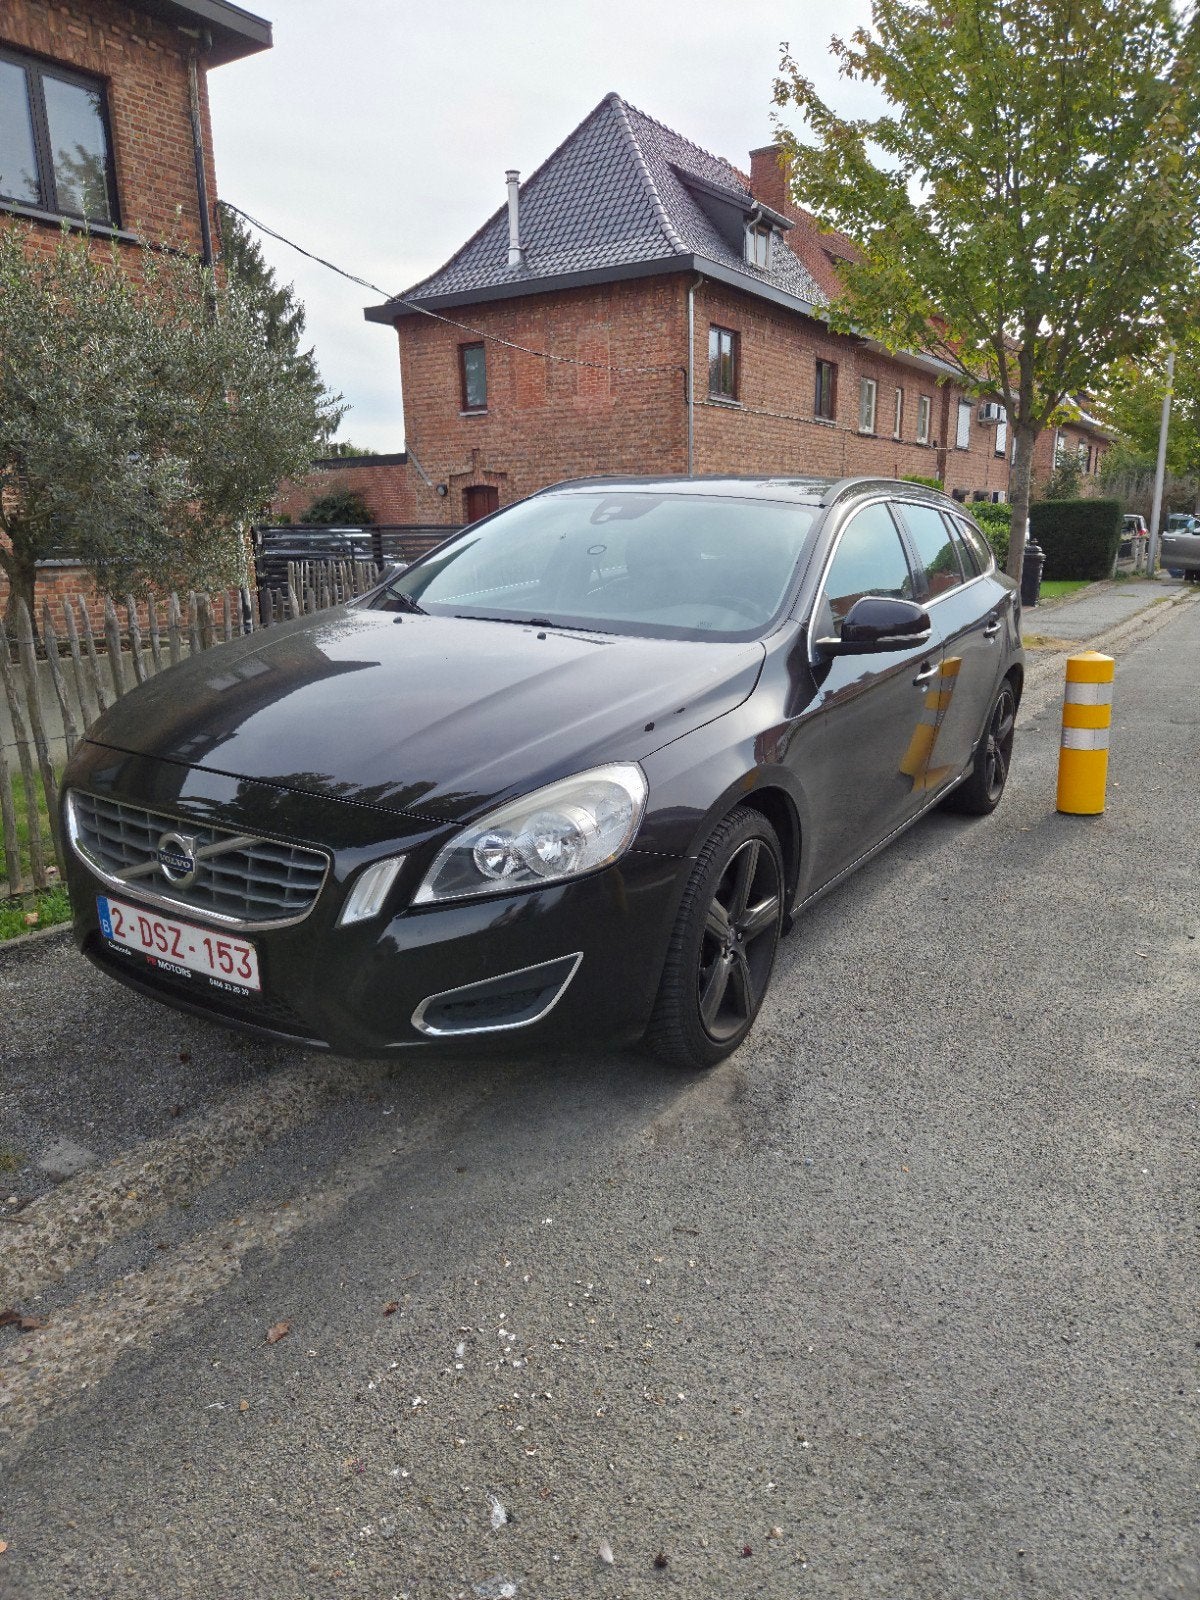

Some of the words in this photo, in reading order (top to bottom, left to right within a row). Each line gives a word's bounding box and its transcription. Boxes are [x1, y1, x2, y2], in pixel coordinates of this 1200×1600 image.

[159, 853, 191, 868] VOLVO
[102, 918, 110, 933] B
[112, 907, 252, 979] 2-DSZ-153
[158, 960, 192, 978] MOTORS
